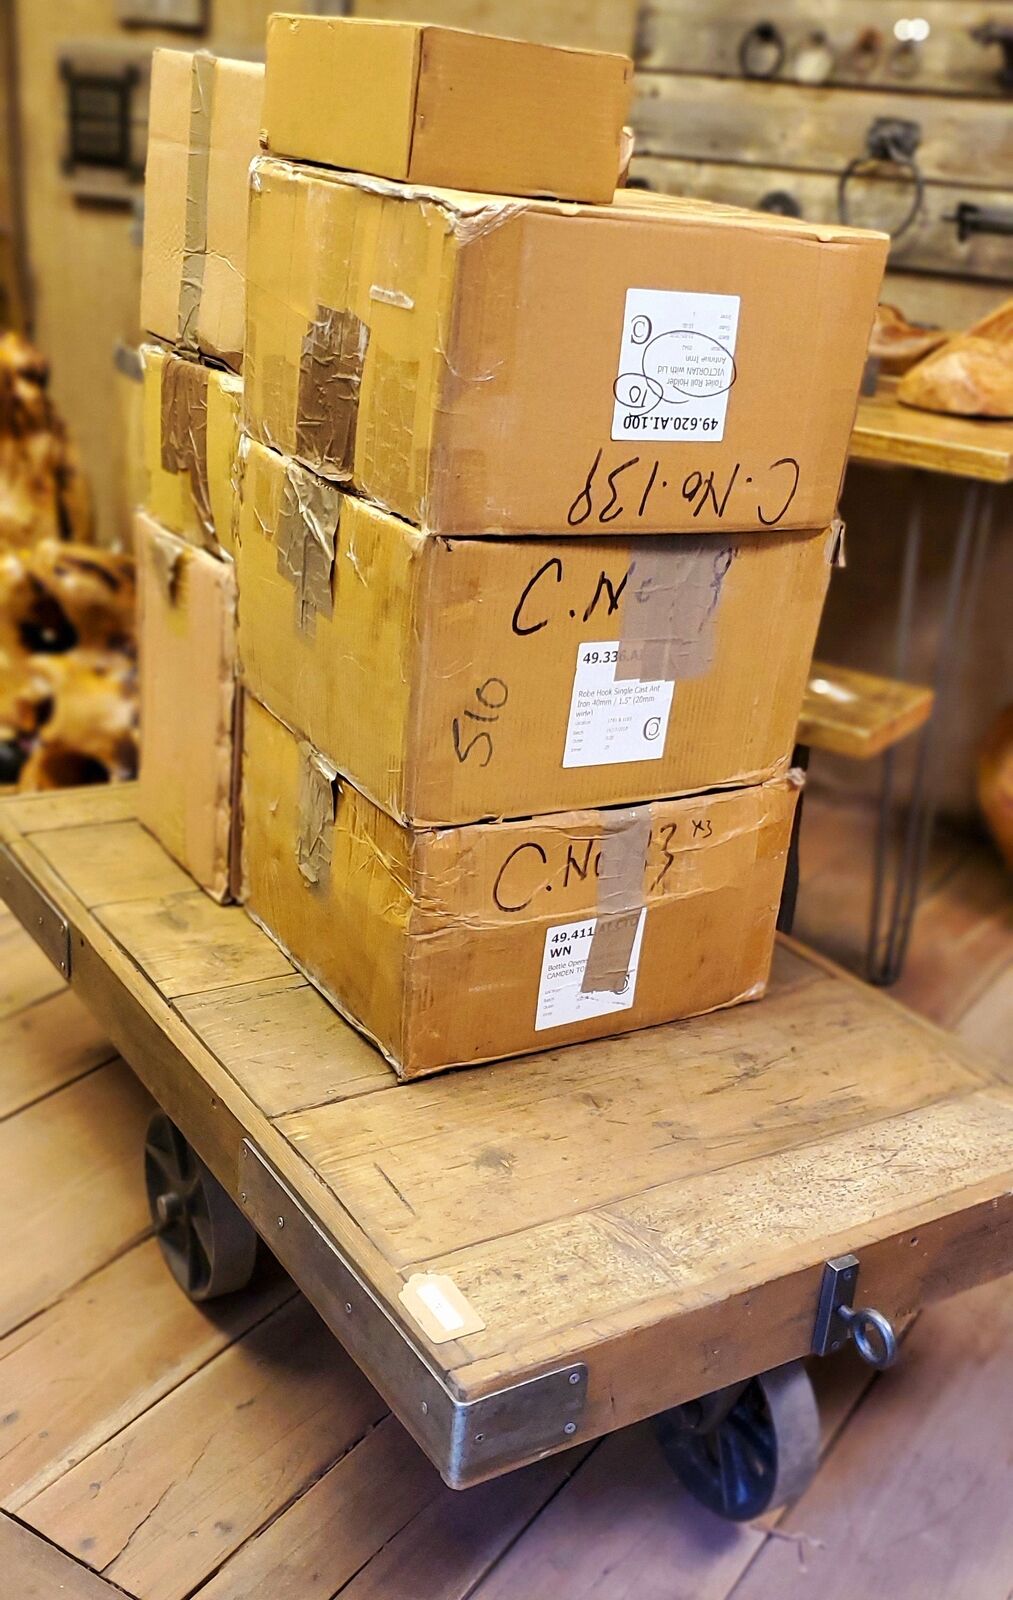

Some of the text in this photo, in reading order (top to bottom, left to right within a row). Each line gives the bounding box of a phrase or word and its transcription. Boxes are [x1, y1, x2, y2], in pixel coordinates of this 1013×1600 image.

[657, 365, 725, 377] VICTORIAN with Lid
[666, 377, 723, 389] Toilet Roll Holder
[623, 416, 719, 431] 49.620.AI.100
[578, 690, 595, 698] Robe
[596, 688, 612, 697] Hook
[614, 687, 634, 696] Single
[550, 945, 572, 959] WN
[547, 961, 567, 972] Bottle
[546, 968, 574, 980] CAMDEN
